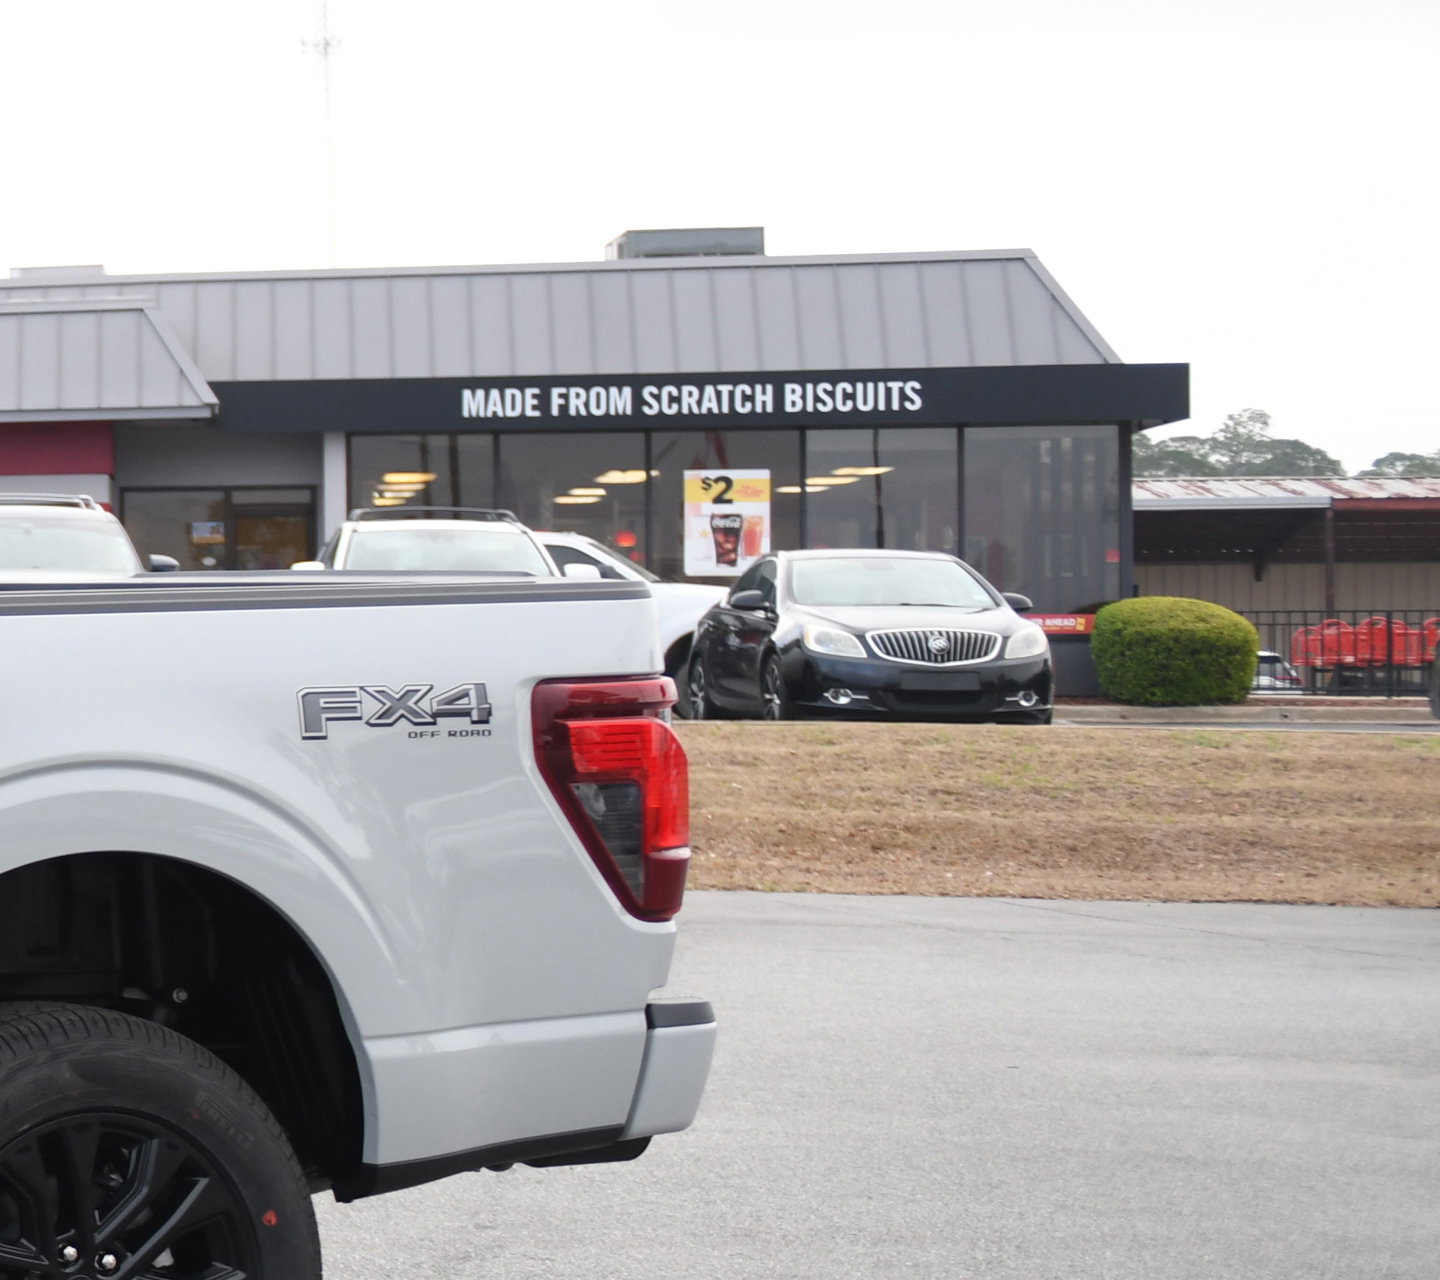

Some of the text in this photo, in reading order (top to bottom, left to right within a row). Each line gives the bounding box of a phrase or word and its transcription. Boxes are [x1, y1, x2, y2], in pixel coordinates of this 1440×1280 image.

[461, 380, 923, 418] MADE FROM SCRATCH BISCUITS
[701, 476, 734, 504] $2
[296, 683, 492, 740] FX4
[408, 729, 492, 739] OFF ROAD
